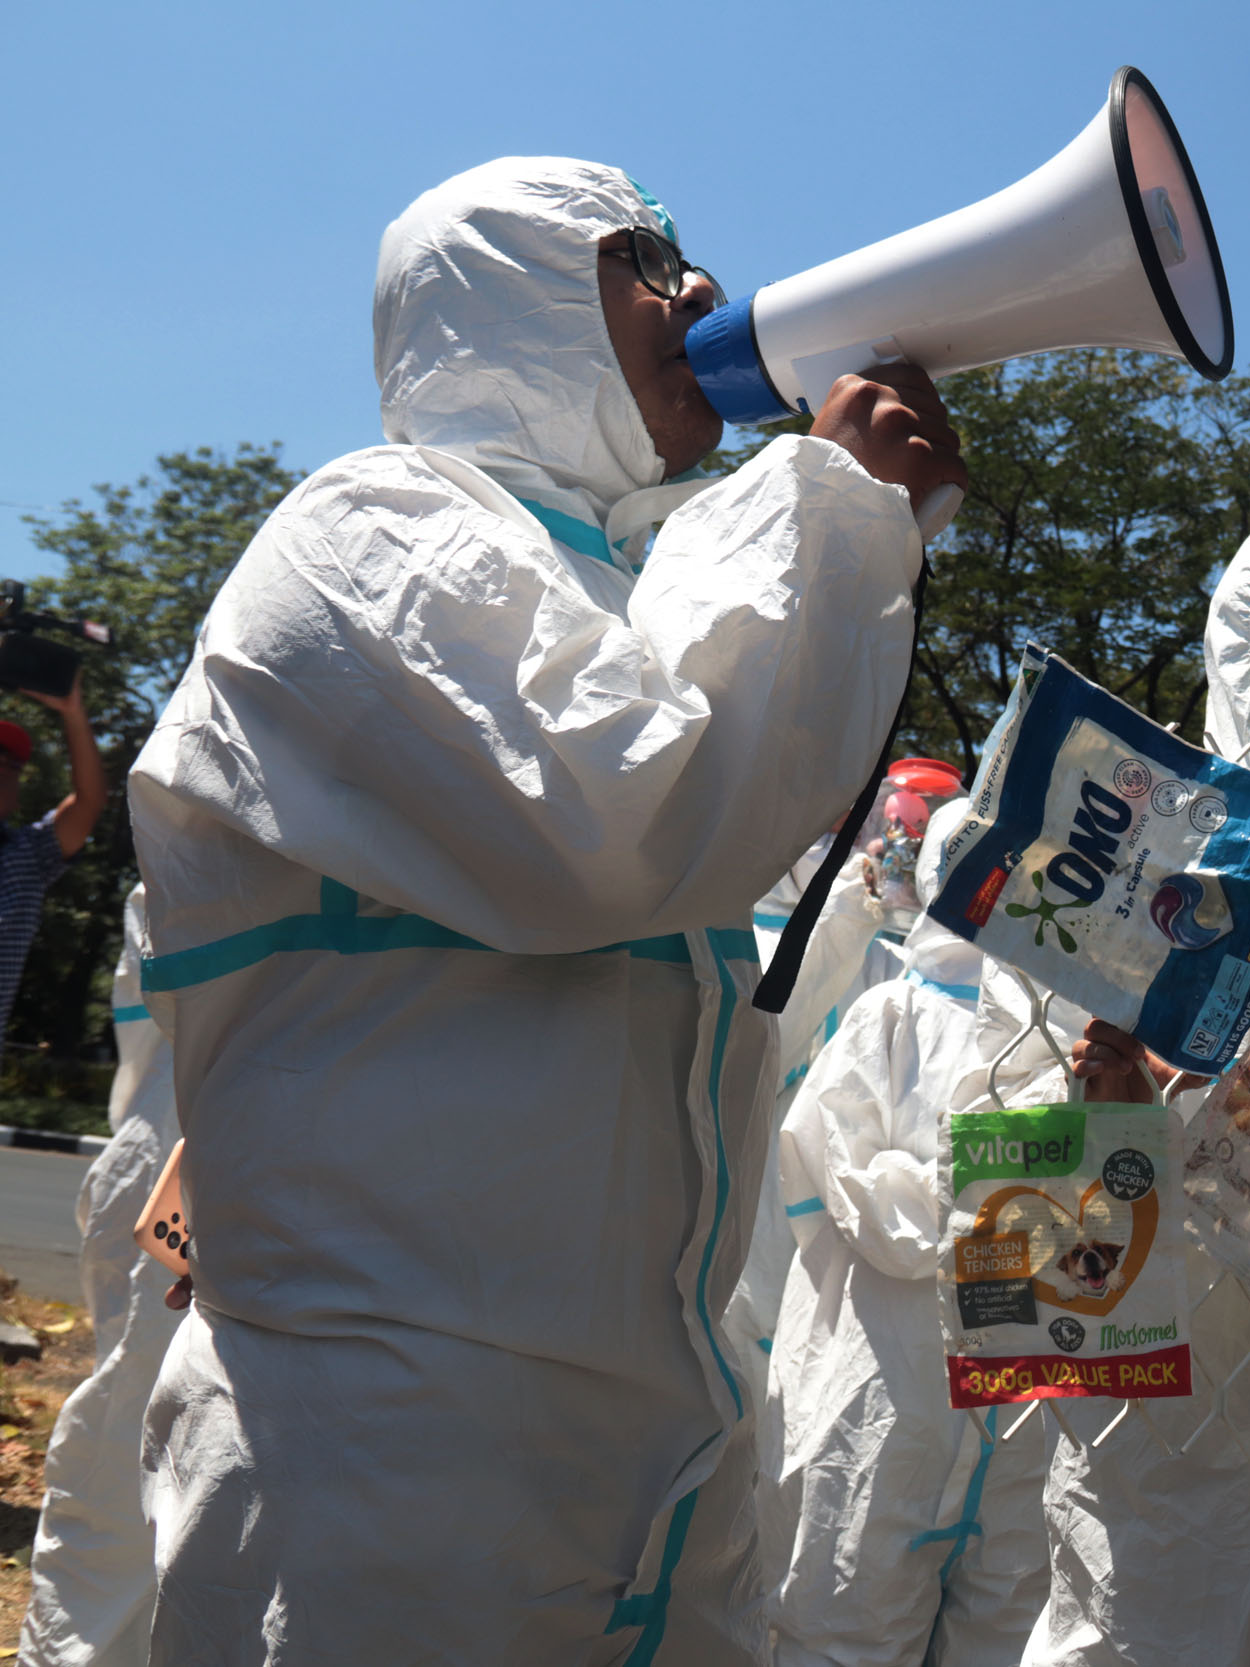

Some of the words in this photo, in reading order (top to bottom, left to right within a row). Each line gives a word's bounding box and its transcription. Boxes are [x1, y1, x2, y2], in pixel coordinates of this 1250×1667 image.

[962, 820, 979, 836] TO
[978, 752, 1002, 820] FUSS-FREE
[1046, 780, 1133, 903] OMO
[1127, 813, 1150, 849] active
[1126, 847, 1151, 892] Capsule
[1115, 905, 1131, 920] 3
[1127, 896, 1136, 909] in
[1191, 1030, 1208, 1055] NP
[1216, 1044, 1234, 1063] DIRT
[1230, 1033, 1240, 1042] IS
[965, 1134, 1073, 1173] vitapet
[1106, 1170, 1150, 1188] CHICKEN
[1118, 1162, 1141, 1176] REAL
[962, 1240, 1023, 1260] CHICKEN
[963, 1256, 1023, 1274] TENDERS
[968, 1367, 1033, 1396] 300g
[1040, 1362, 1112, 1388] VALUE
[1119, 1362, 1178, 1388] PACK
